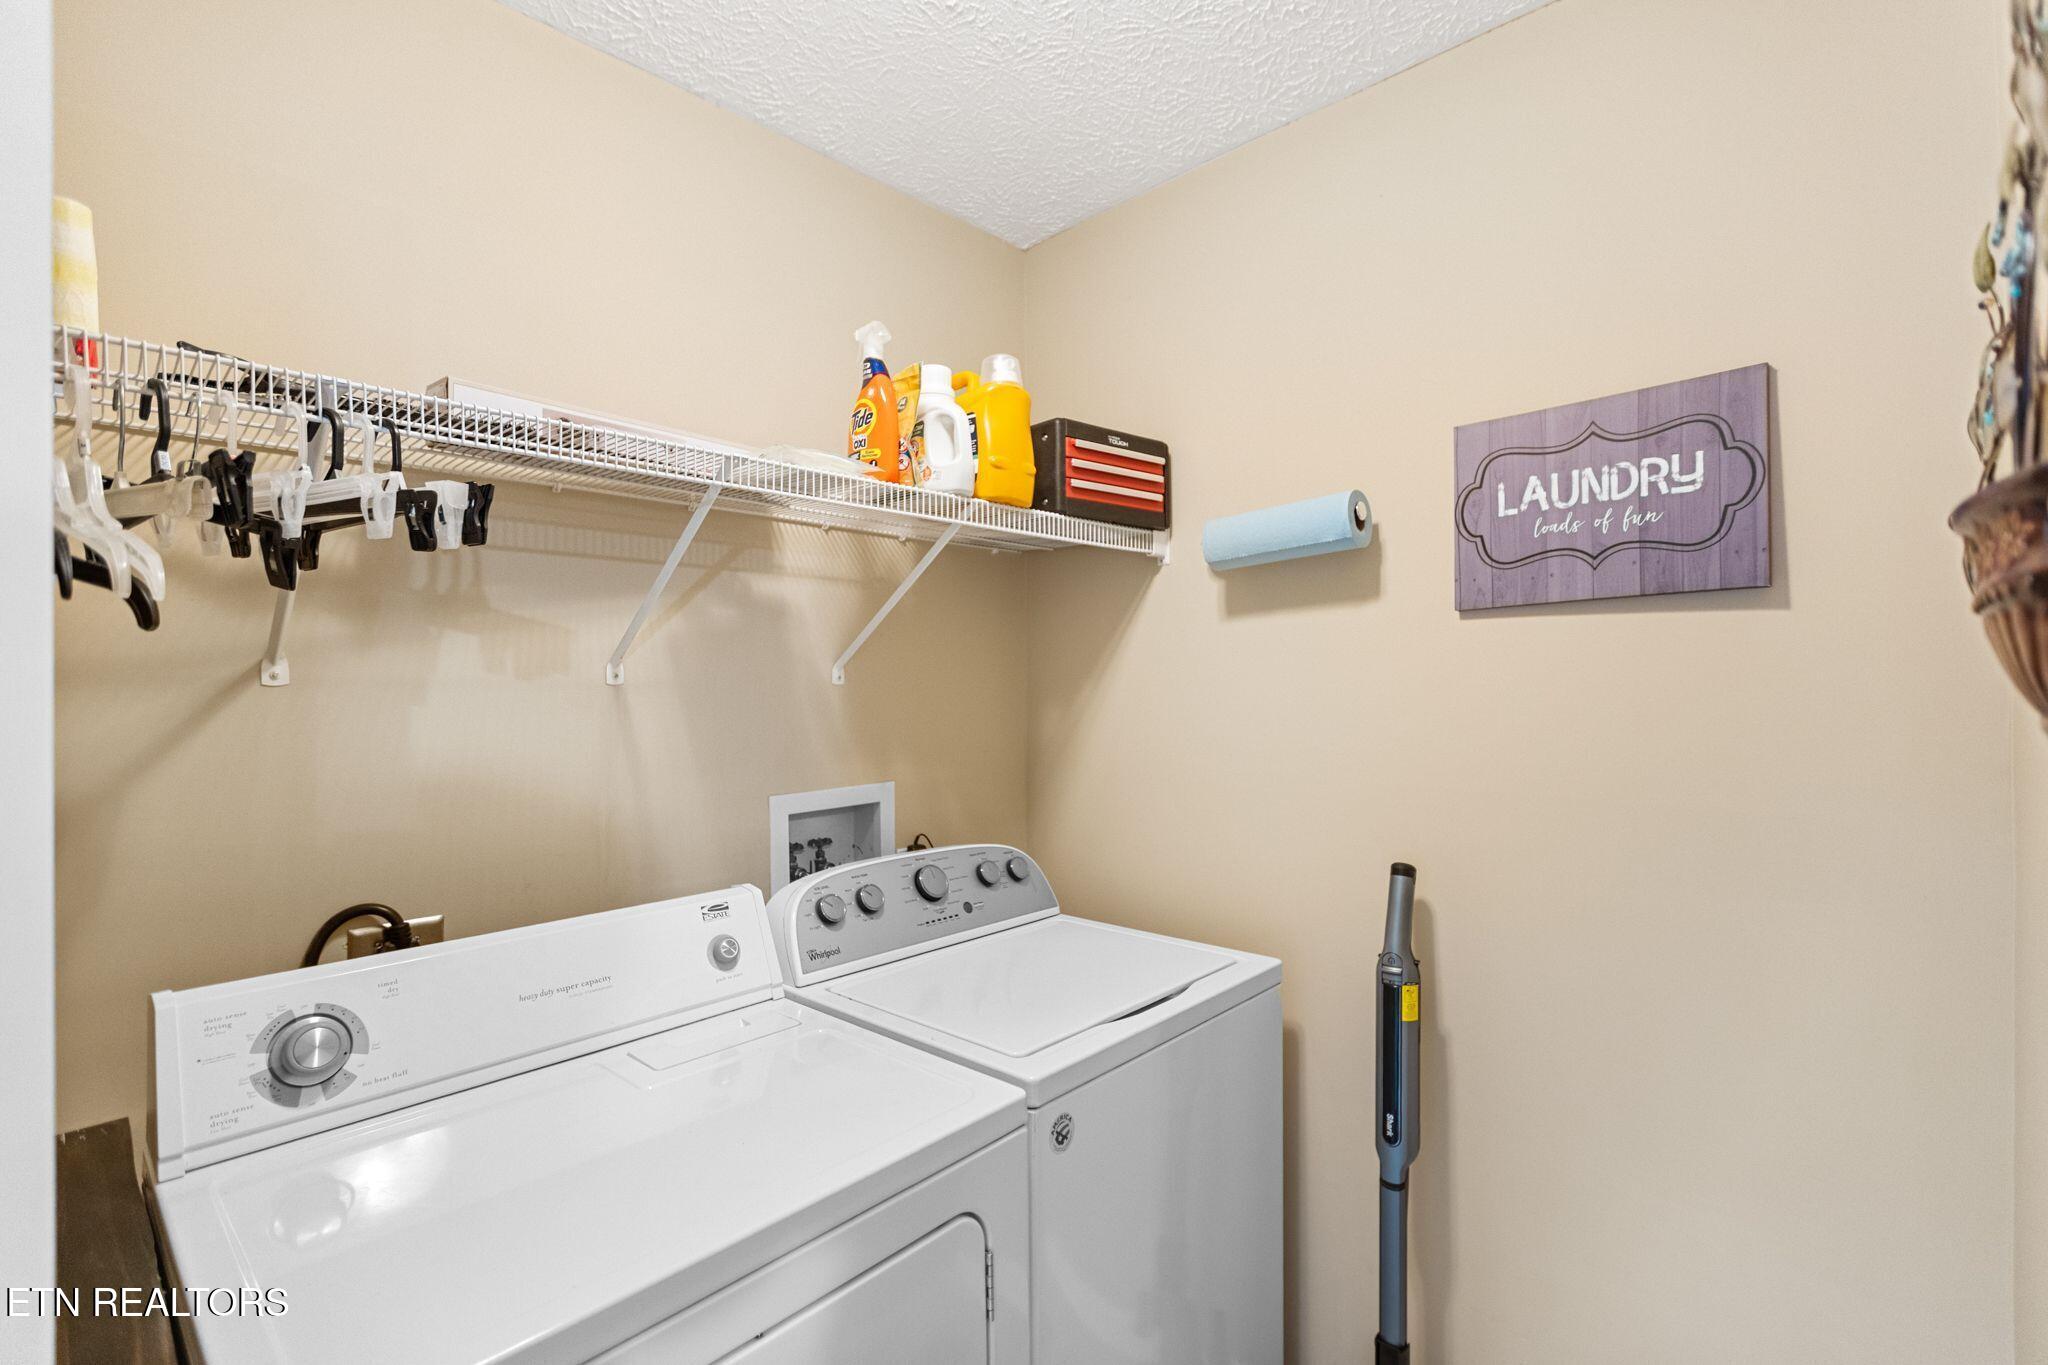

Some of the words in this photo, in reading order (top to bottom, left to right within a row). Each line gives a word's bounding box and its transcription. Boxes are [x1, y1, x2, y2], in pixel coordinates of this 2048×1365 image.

[852, 408, 874, 435] Tide
[854, 438, 867, 450] OXI
[1497, 450, 1704, 517] LAUNDRY
[1534, 511, 1584, 538] loads
[1594, 508, 1614, 534] of
[1622, 505, 1664, 532] fun
[808, 946, 841, 961] Whirlpool
[519, 993, 539, 1003] heavy
[540, 988, 555, 998] duty
[556, 983, 579, 994] super
[581, 976, 612, 988] capacity
[203, 1022, 233, 1033] drying
[209, 1117, 239, 1129] drying
[1386, 1113, 1394, 1137] Shark
